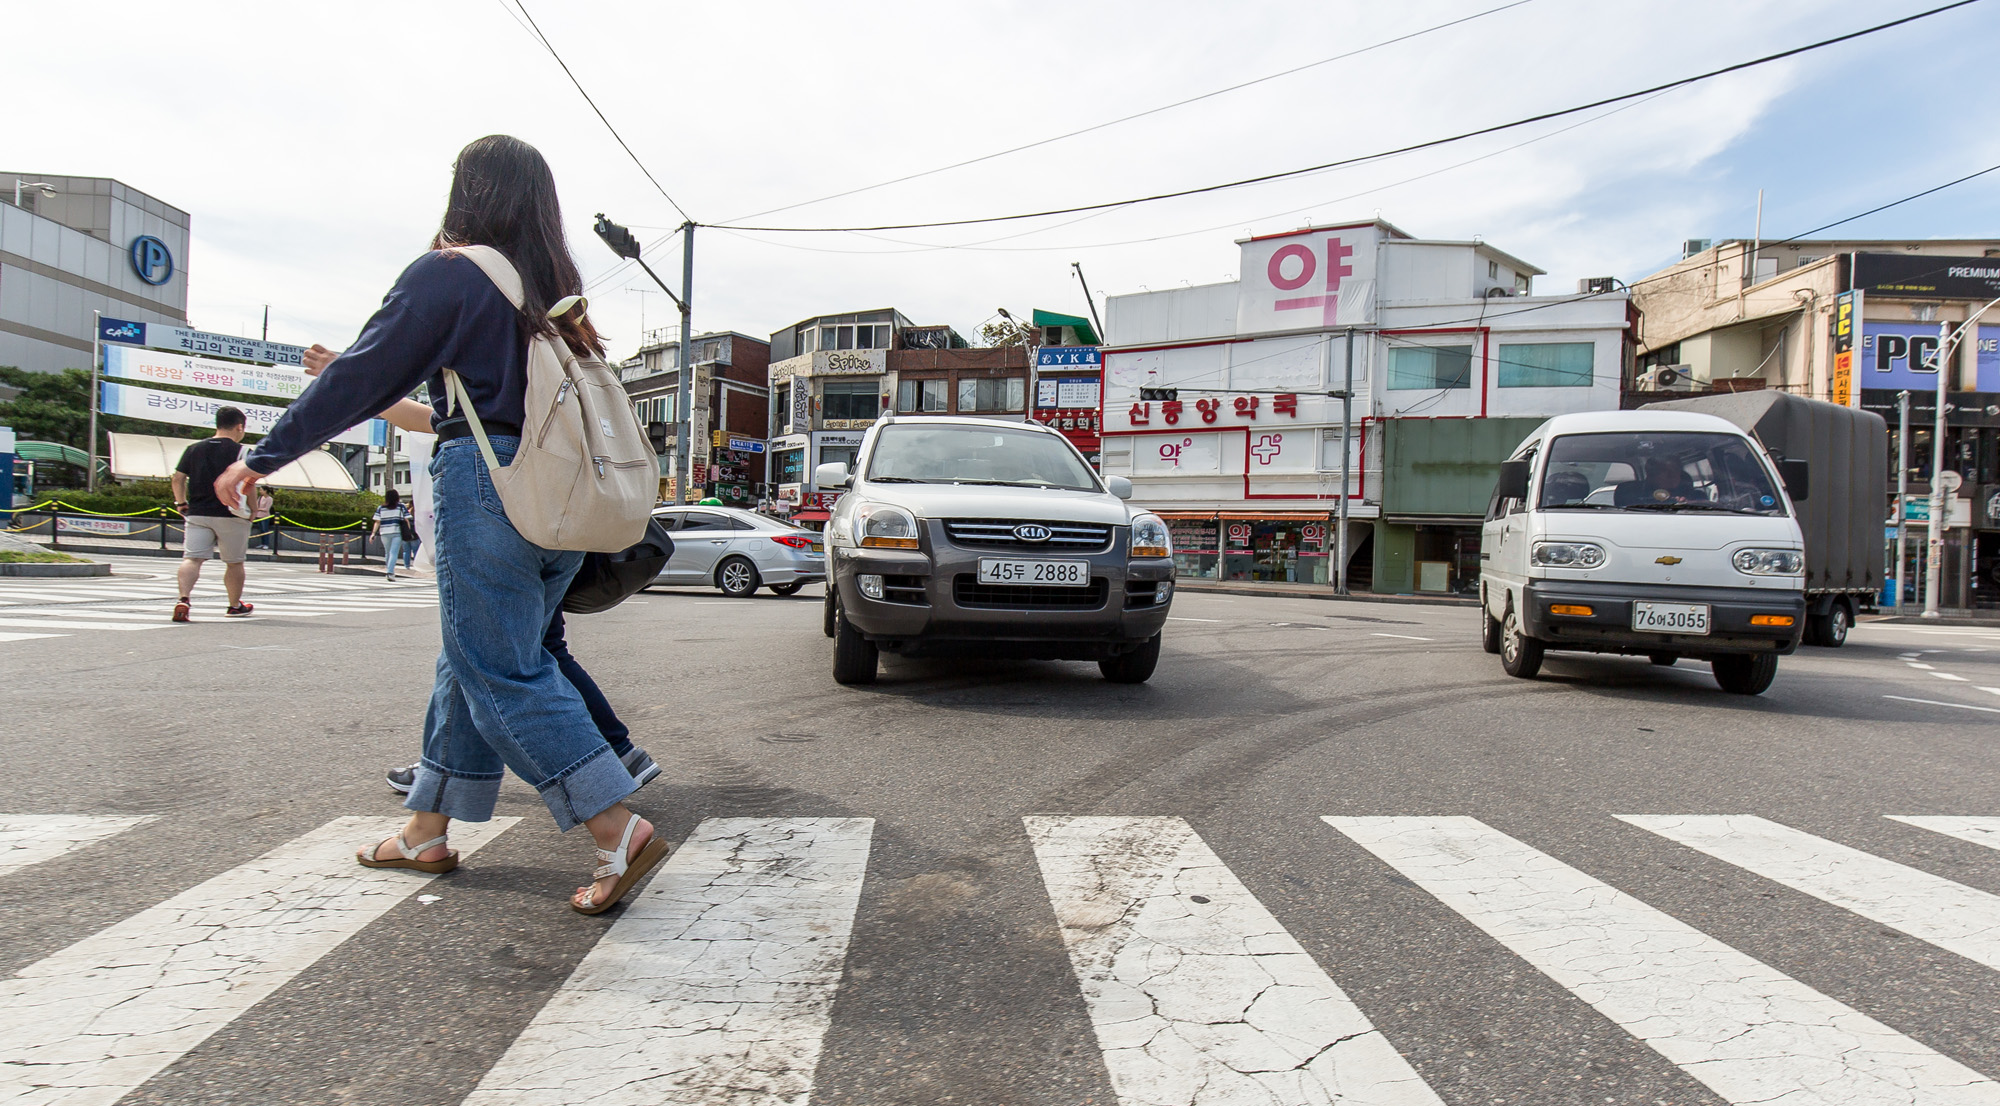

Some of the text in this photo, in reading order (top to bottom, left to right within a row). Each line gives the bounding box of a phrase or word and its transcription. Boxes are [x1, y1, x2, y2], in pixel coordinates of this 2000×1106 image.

[1267, 237, 1352, 327] 약
[1948, 266, 2000, 279] PREMIUM
[1838, 303, 1852, 336] PC
[175, 329, 189, 337] THE
[191, 332, 209, 340] BEST
[266, 343, 279, 352] THE
[281, 345, 297, 353] BEST
[180, 338, 302, 365] 최고의 진료 최고의
[828, 354, 871, 371] Spiky
[1875, 333, 1941, 373] PC
[139, 364, 303, 395] 대장암 유방암 폐암 위암
[1128, 393, 1298, 426] 신중앙약국
[1159, 443, 1183, 467] 약
[693, 463, 706, 483] 도장
[1020, 527, 1046, 538] KIA
[1229, 524, 1251, 546] 약
[1302, 525, 1326, 548] 약
[990, 563, 1078, 581] 45두 2888
[1637, 610, 1706, 629] 76어3055
